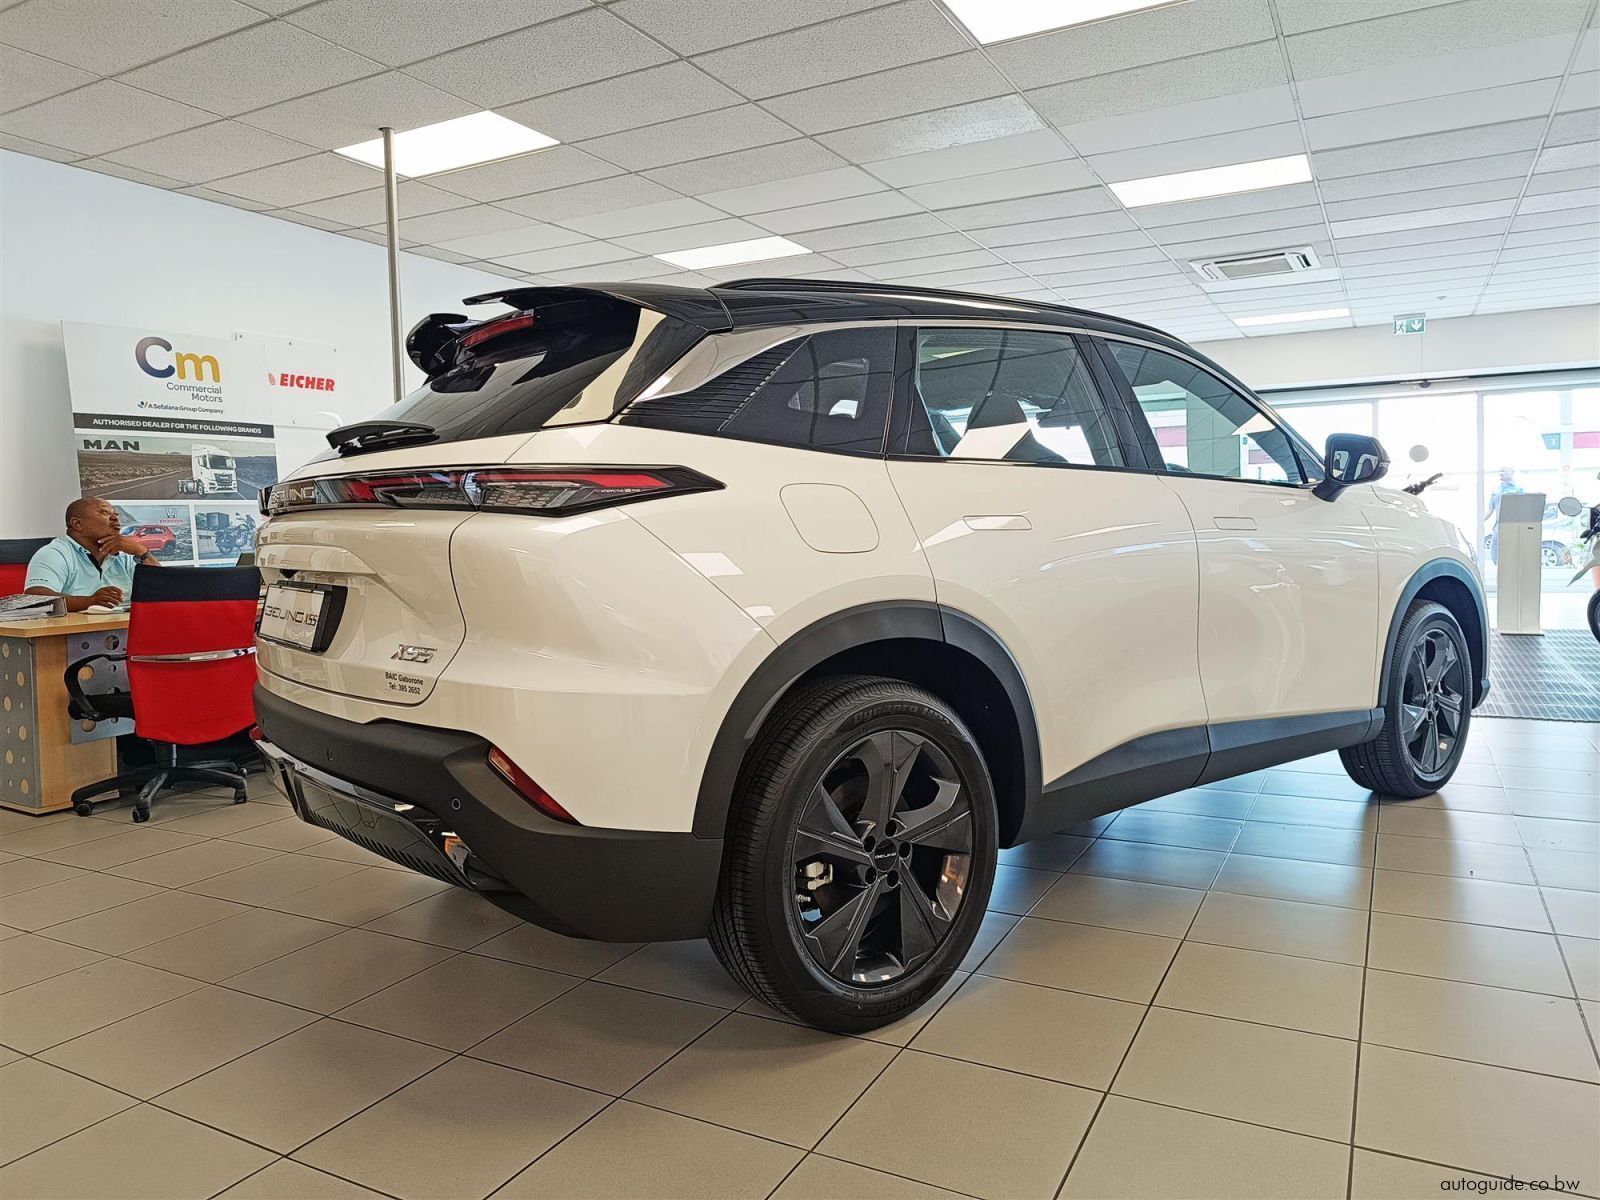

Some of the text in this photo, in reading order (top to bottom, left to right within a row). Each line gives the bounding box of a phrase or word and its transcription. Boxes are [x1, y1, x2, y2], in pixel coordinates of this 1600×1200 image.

[135, 336, 220, 383] Cm
[166, 382, 222, 394] Commercial
[280, 373, 335, 391] EICHER
[191, 393, 223, 403] Motors
[180, 405, 197, 413] Group
[198, 406, 223, 414] Company
[92, 418, 142, 427] AUTHORISED
[142, 420, 170, 429] DEALER
[200, 424, 237, 433] FOLLOWING
[237, 426, 262, 434] BRANDS
[83, 439, 140, 451] MAN
[265, 605, 305, 624] BEIJING
[390, 644, 437, 664] X55
[385, 671, 424, 686] BAIC Gaborone
[398, 684, 408, 693] 395
